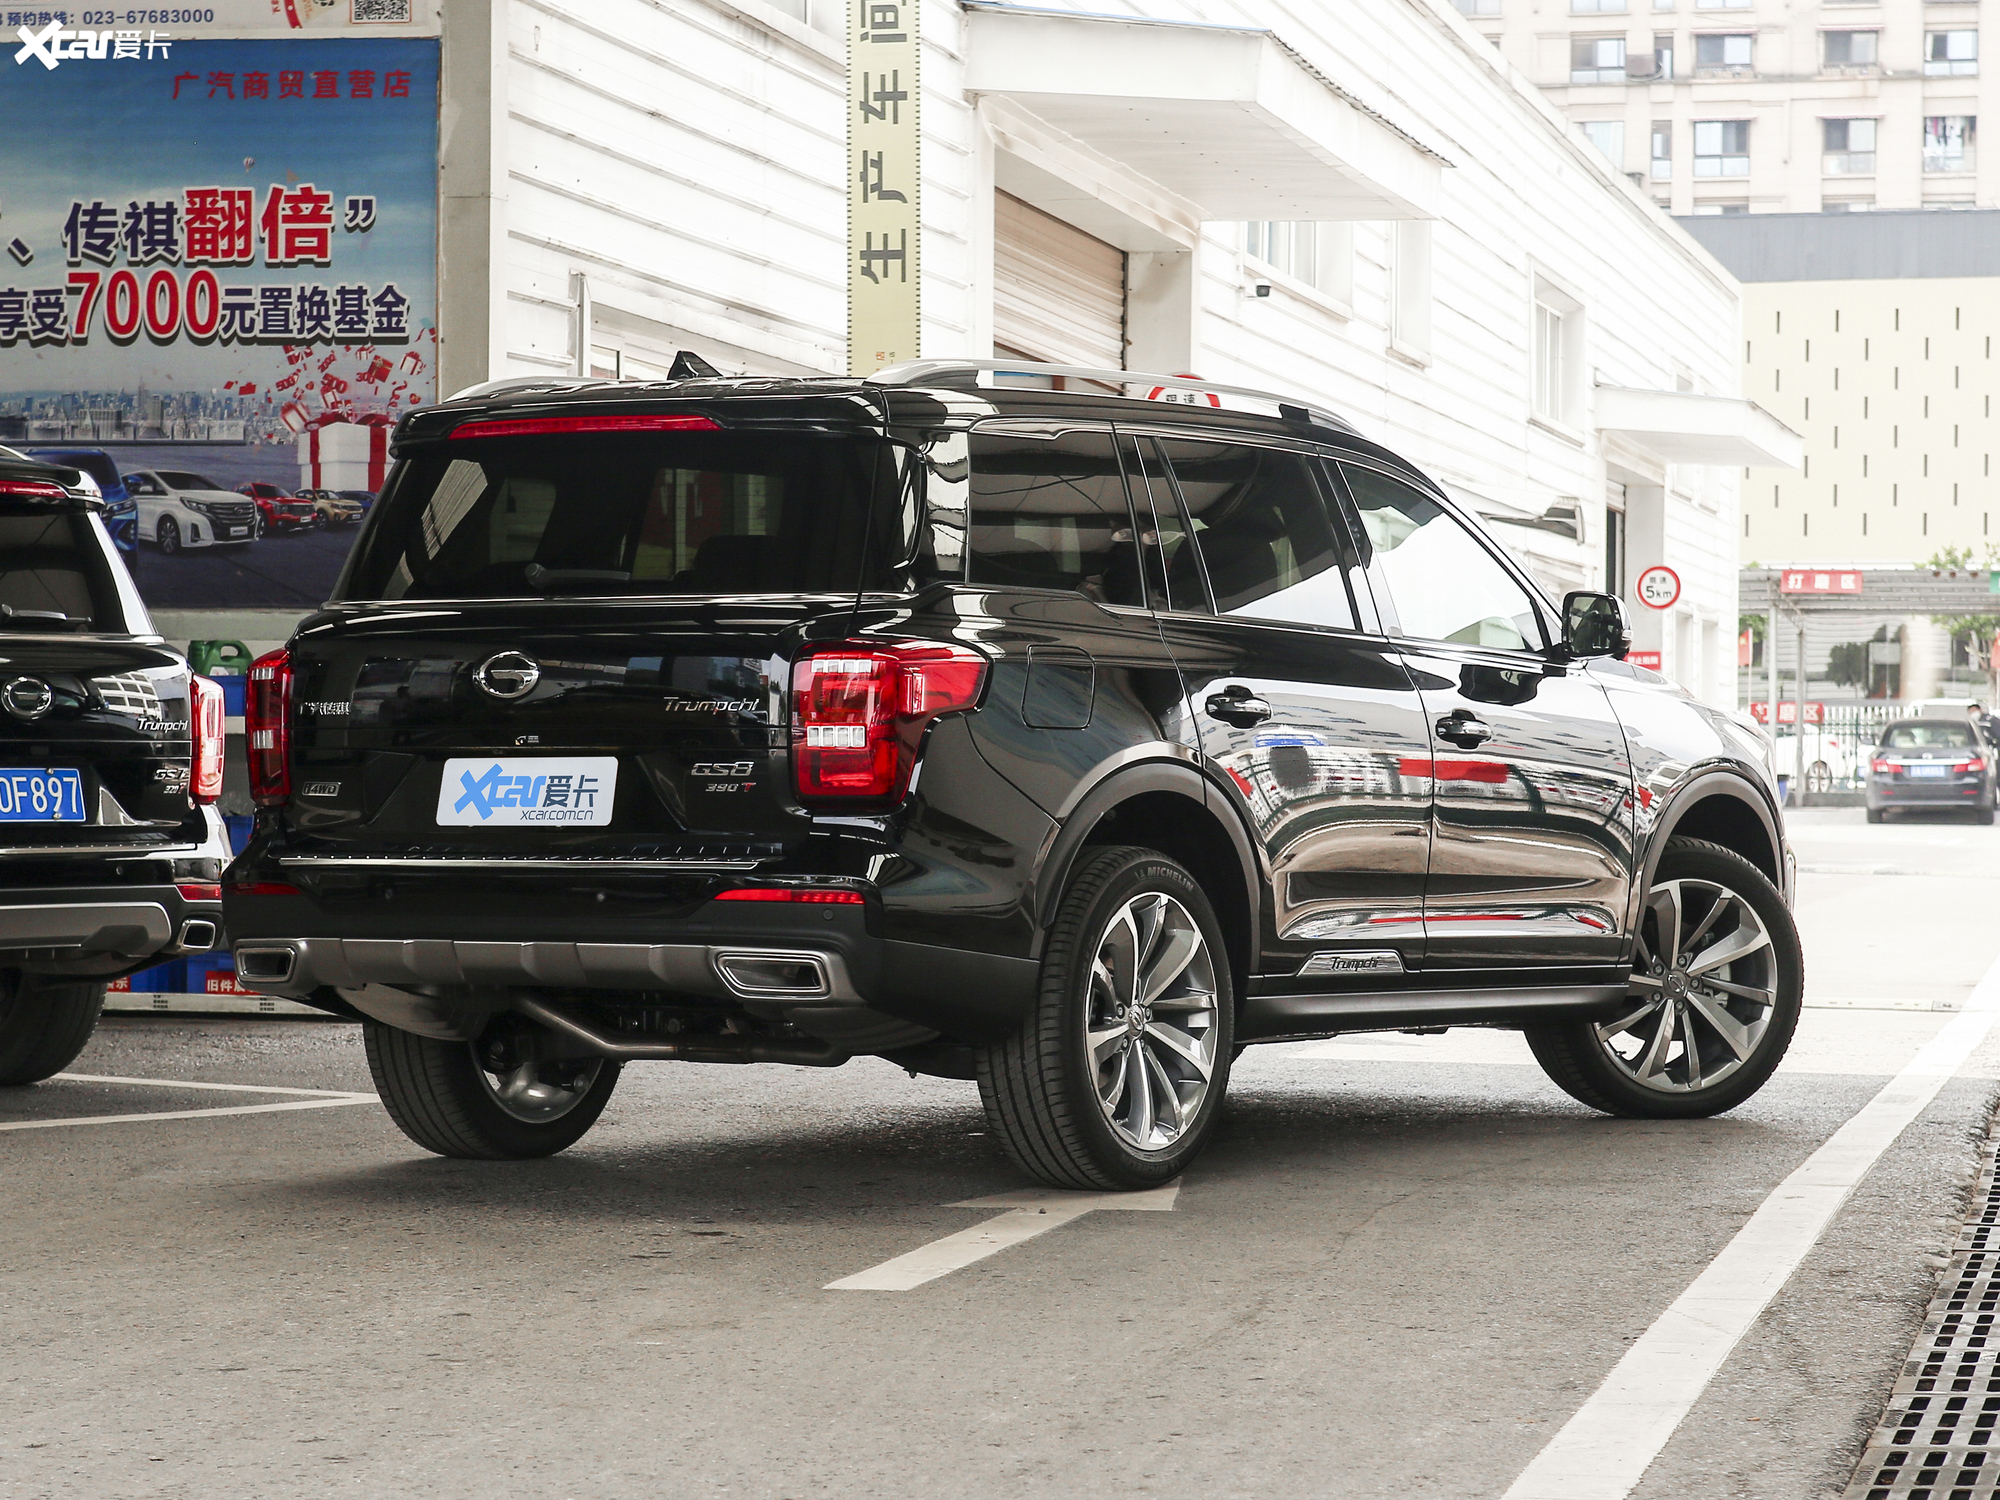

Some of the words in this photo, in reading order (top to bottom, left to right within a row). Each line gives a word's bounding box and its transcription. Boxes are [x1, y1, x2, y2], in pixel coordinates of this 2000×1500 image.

[83, 9, 214, 25] 023-67683000
[172, 70, 412, 100] 广汽商贸直营店
[1788, 573, 1856, 590] 打磨区
[1646, 586, 1672, 599] 5km
[663, 696, 760, 715] Trumpchi
[691, 761, 755, 776] GS8
[520, 810, 594, 821] xcar.com.cn
[1147, 866, 1194, 892] MICHELIN
[1331, 956, 1380, 971] Trumpchi
